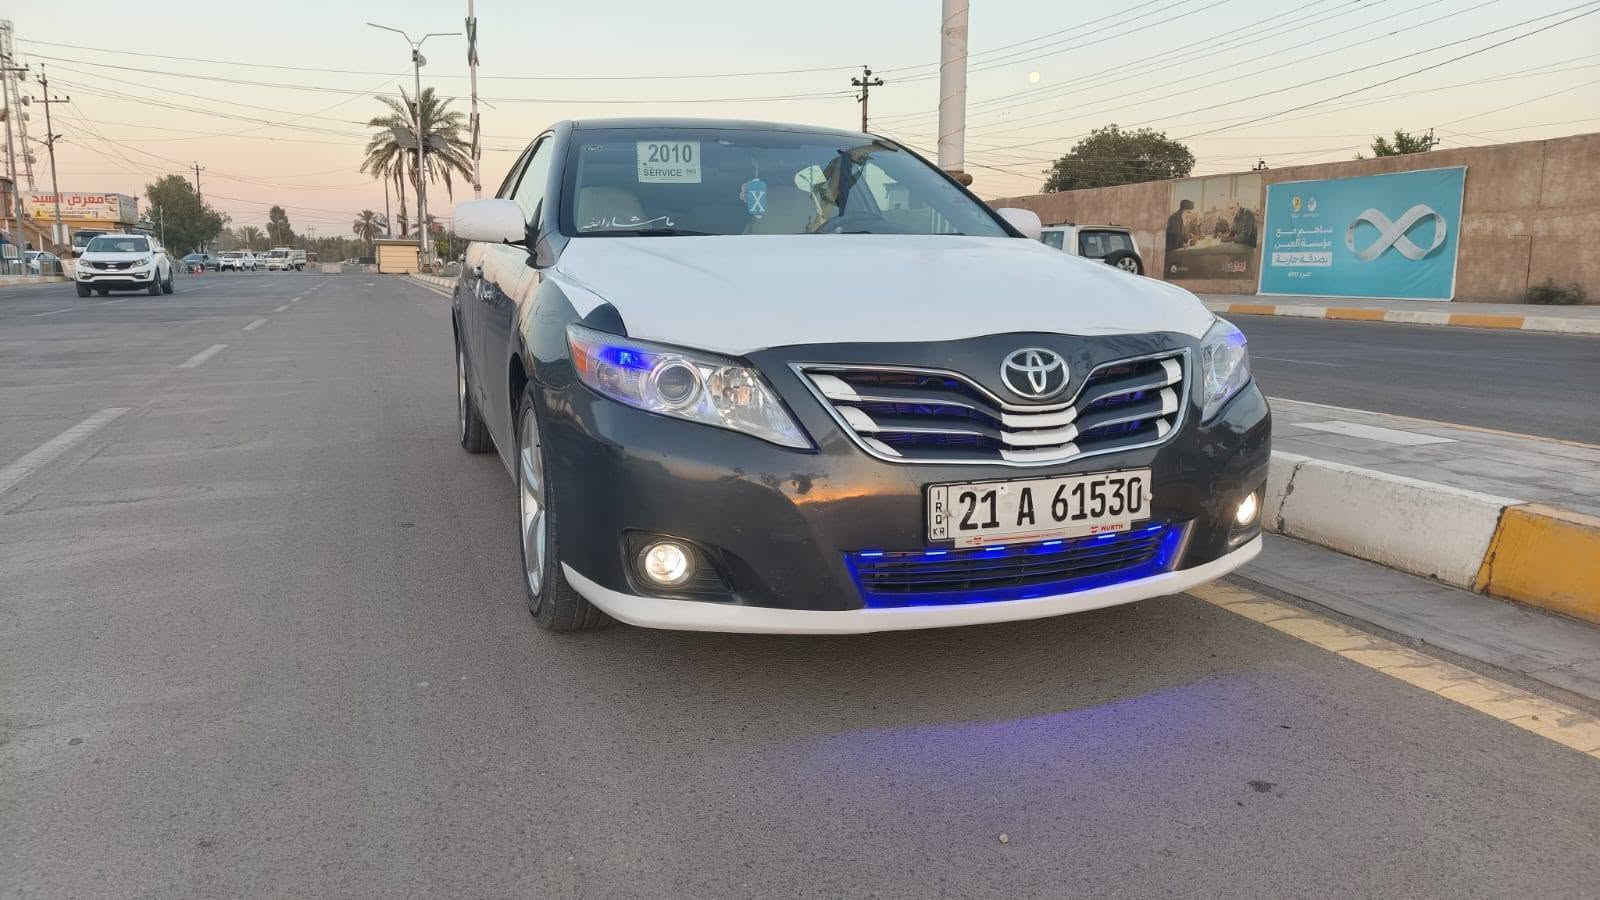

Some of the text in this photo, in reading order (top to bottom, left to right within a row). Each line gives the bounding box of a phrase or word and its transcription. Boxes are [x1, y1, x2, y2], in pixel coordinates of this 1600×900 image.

[649, 144, 692, 163] 2010
[643, 168, 683, 177] SERVICE
[67, 192, 104, 206] معرض
[958, 476, 1143, 531] 21 A 61530
[933, 528, 945, 537] KR
